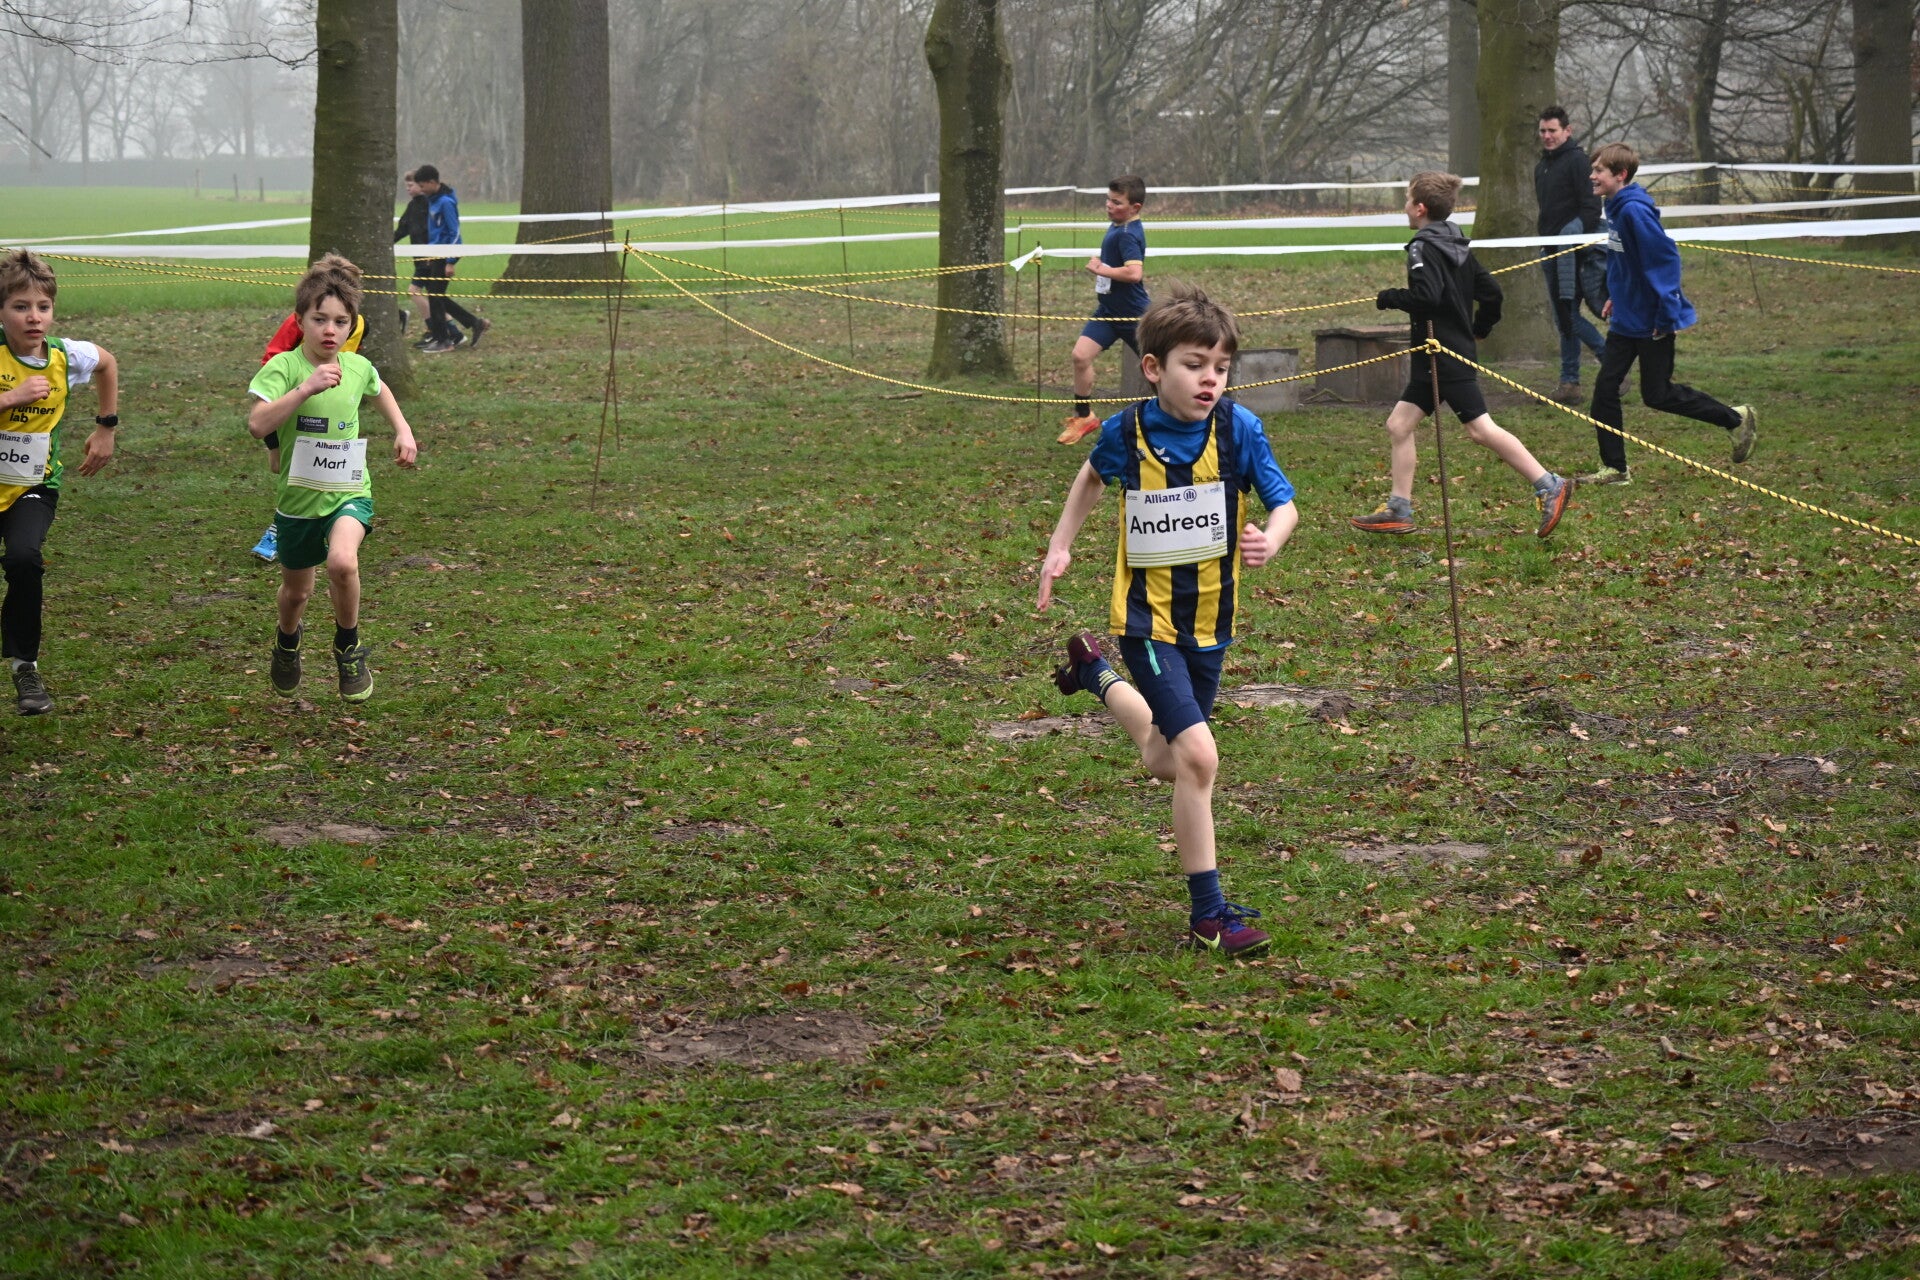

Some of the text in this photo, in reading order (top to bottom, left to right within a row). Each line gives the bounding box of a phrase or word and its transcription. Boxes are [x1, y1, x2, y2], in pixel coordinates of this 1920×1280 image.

[9, 412, 29, 423] lab
[315, 441, 341, 450] Allianz
[313, 456, 347, 470] Mart
[1144, 493, 1181, 505] Allianz
[1130, 512, 1220, 535] Andreas
